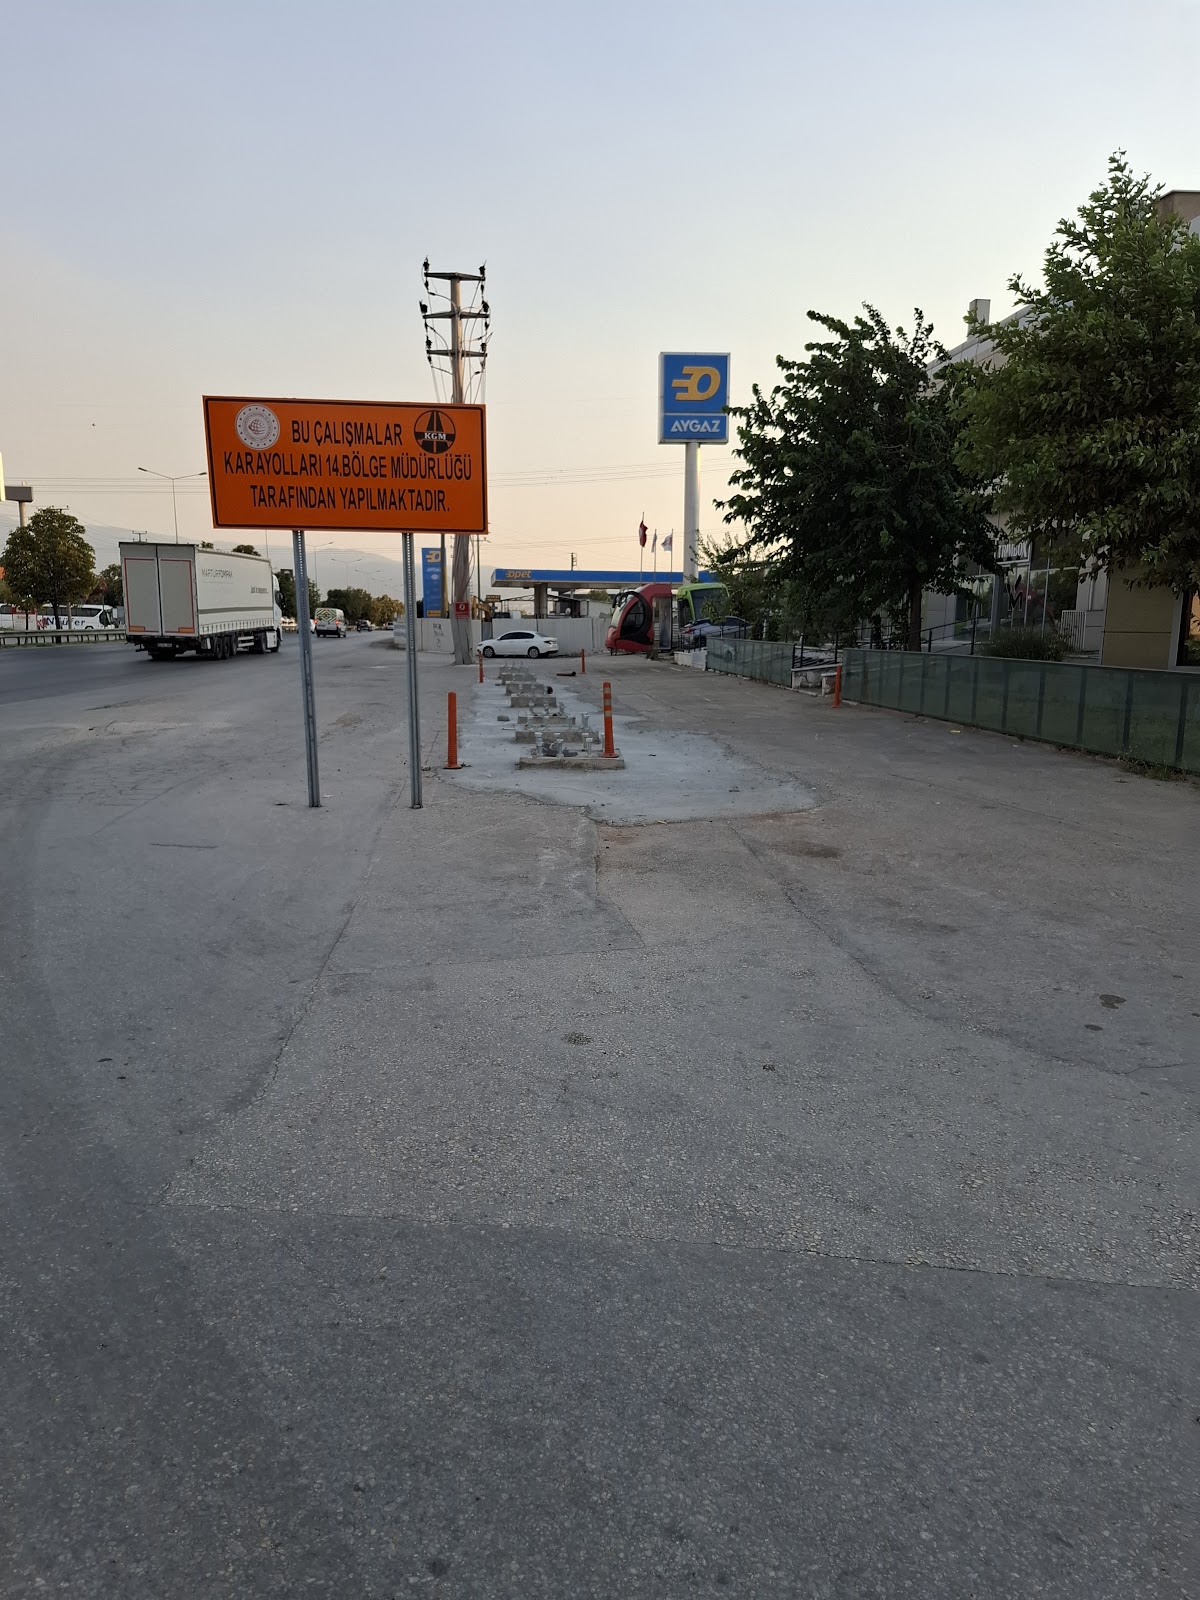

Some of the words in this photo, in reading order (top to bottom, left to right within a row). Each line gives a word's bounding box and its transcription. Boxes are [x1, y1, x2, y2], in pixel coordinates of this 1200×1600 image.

[292, 420, 310, 443] BU
[313, 421, 403, 447] ÇALIŞMALAR
[423, 431, 447, 441] KGM
[670, 419, 721, 433] AYGAZ
[223, 451, 323, 477] KARAYOLLARI
[325, 450, 387, 479] 14.BÖLGE
[390, 453, 473, 481] MÜDÜRLÜĞÜ
[249, 484, 336, 510] TARAFINDAN
[339, 486, 450, 513] YAPILMAKTADIR.
[506, 570, 532, 579] opet
